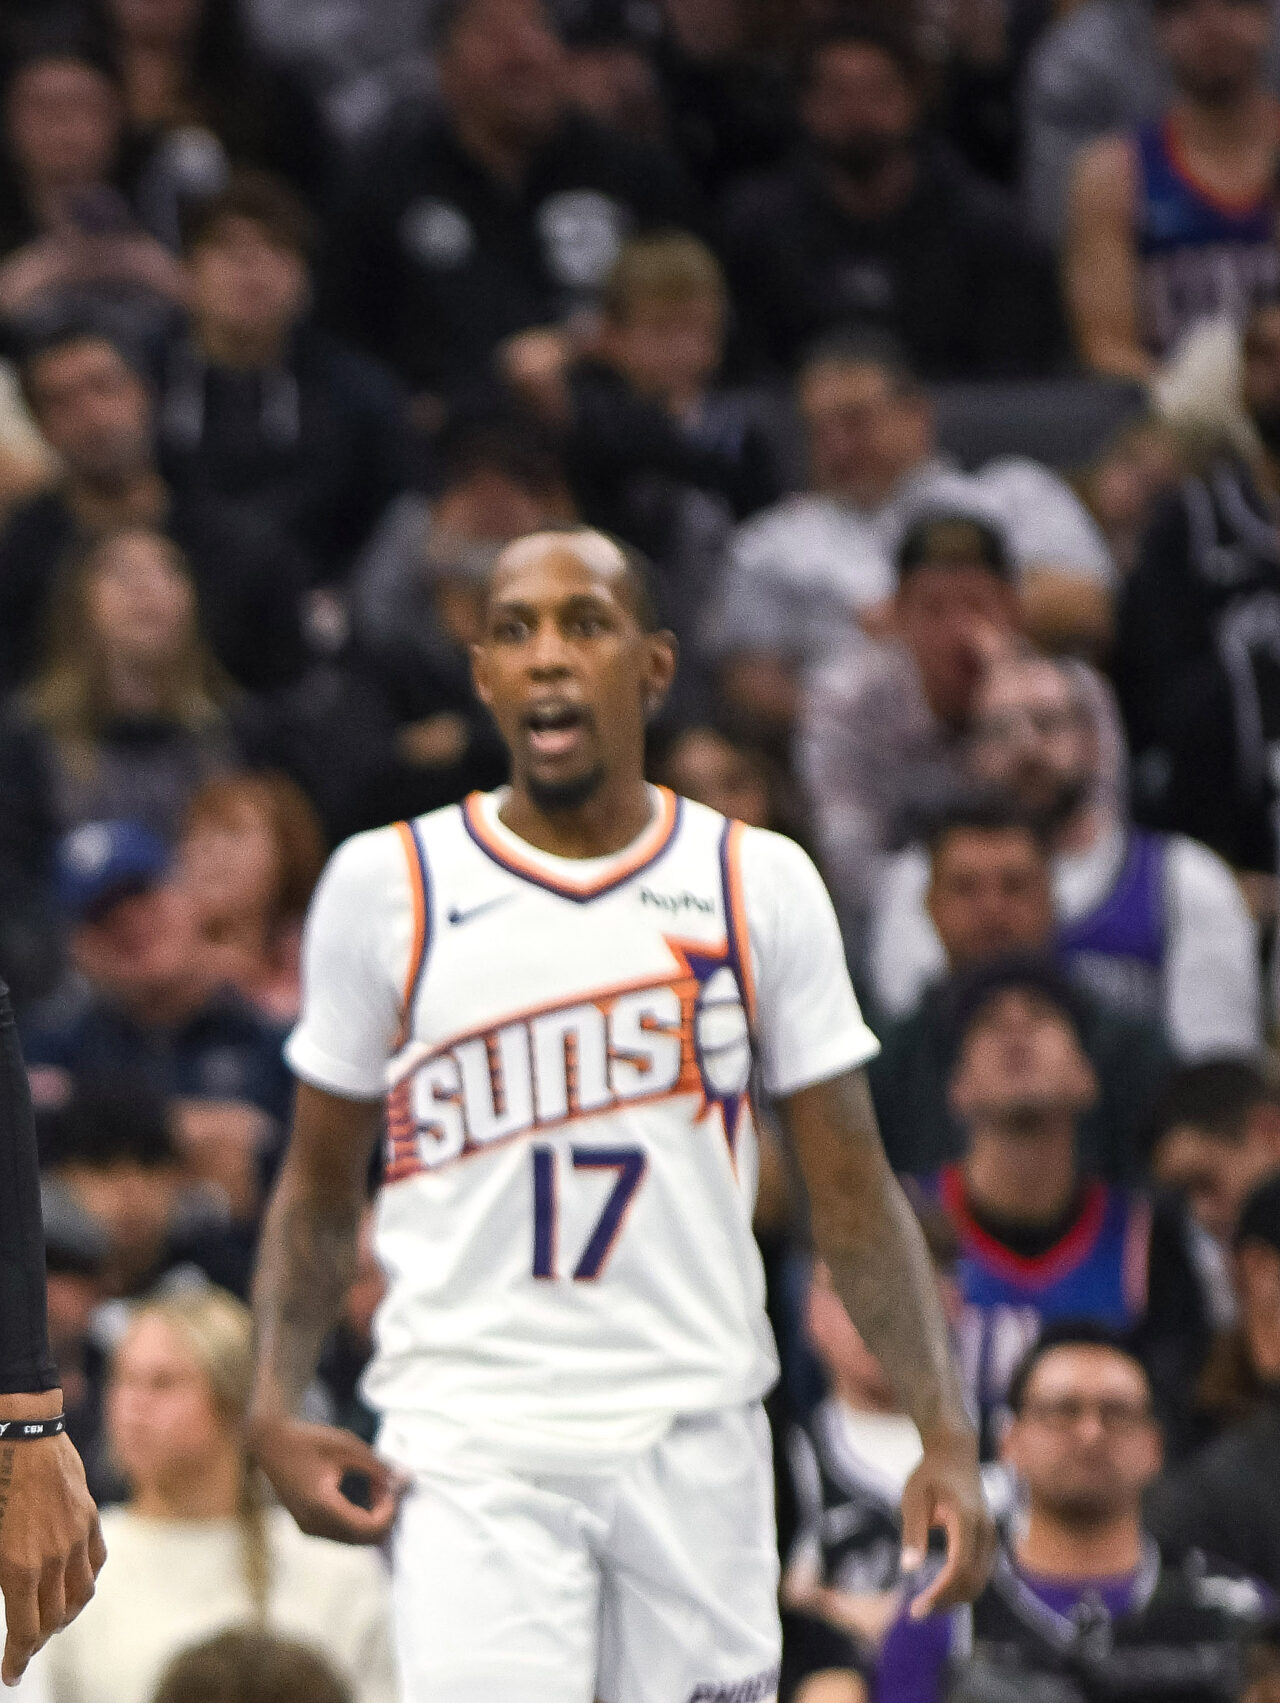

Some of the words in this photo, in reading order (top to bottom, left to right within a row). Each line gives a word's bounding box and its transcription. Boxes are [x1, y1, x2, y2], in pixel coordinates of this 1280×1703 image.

[640, 887, 715, 917] PayPal
[410, 986, 682, 1167] SUNS
[532, 1143, 648, 1282] 17
